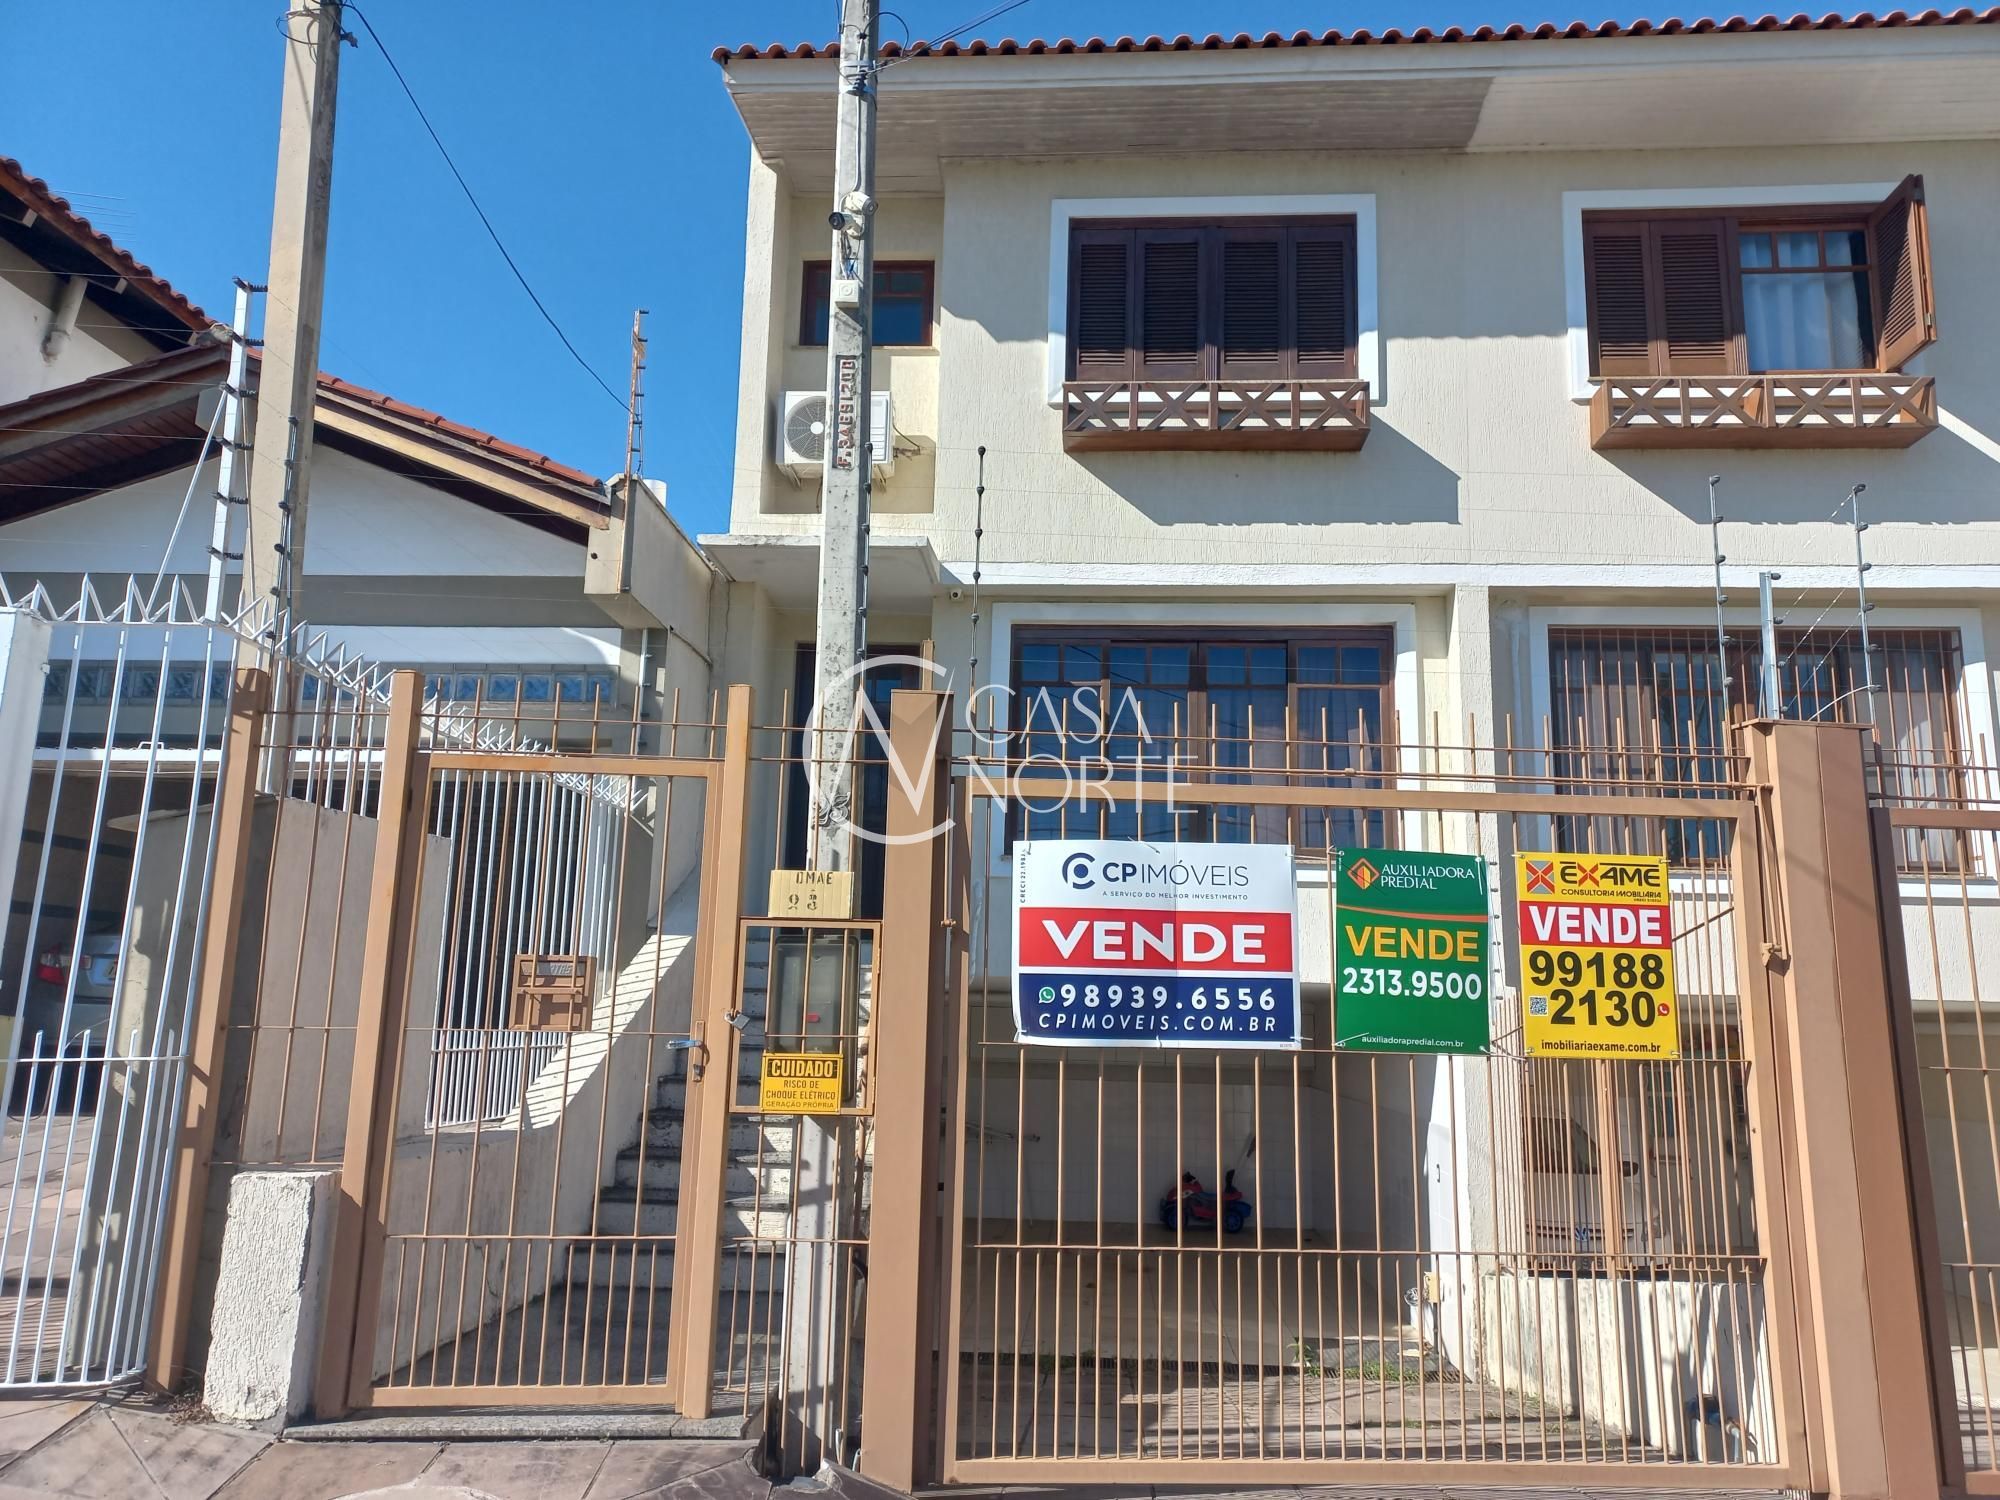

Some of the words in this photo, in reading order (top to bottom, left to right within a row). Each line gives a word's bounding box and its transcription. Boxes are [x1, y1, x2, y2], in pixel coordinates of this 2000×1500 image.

[1381, 863, 1475, 879] AUXILIADORA
[1559, 860, 1661, 888] EXAME
[1381, 876, 1438, 890] PREDIAL
[1110, 890, 1143, 898] SERVIÇO
[1192, 893, 1249, 901] INVESTIMENTO
[1561, 888, 1616, 898] CONSULTORIA
[1528, 905, 1663, 945] VENDE
[1041, 919, 1266, 964] VENDE
[1344, 925, 1480, 962] VENDE
[1528, 949, 1665, 990] 99188
[1342, 966, 1482, 1001] 2313.9500
[1060, 983, 1275, 1011] 98939.6556
[1550, 988, 1656, 1028] 2130
[1038, 1012, 1277, 1032] CPIMOVEIS.COM.BR
[1361, 1035, 1465, 1049] auxiliadorapredial.com.br
[1541, 1039, 1662, 1053] imobiliariaexame.com.br
[771, 1059, 833, 1078] CUIDADO
[783, 1079, 807, 1089] RISCO
[809, 1080, 820, 1089] DE
[766, 1090, 797, 1099] CHOQUE
[799, 1090, 836, 1101] ELÉTRICO
